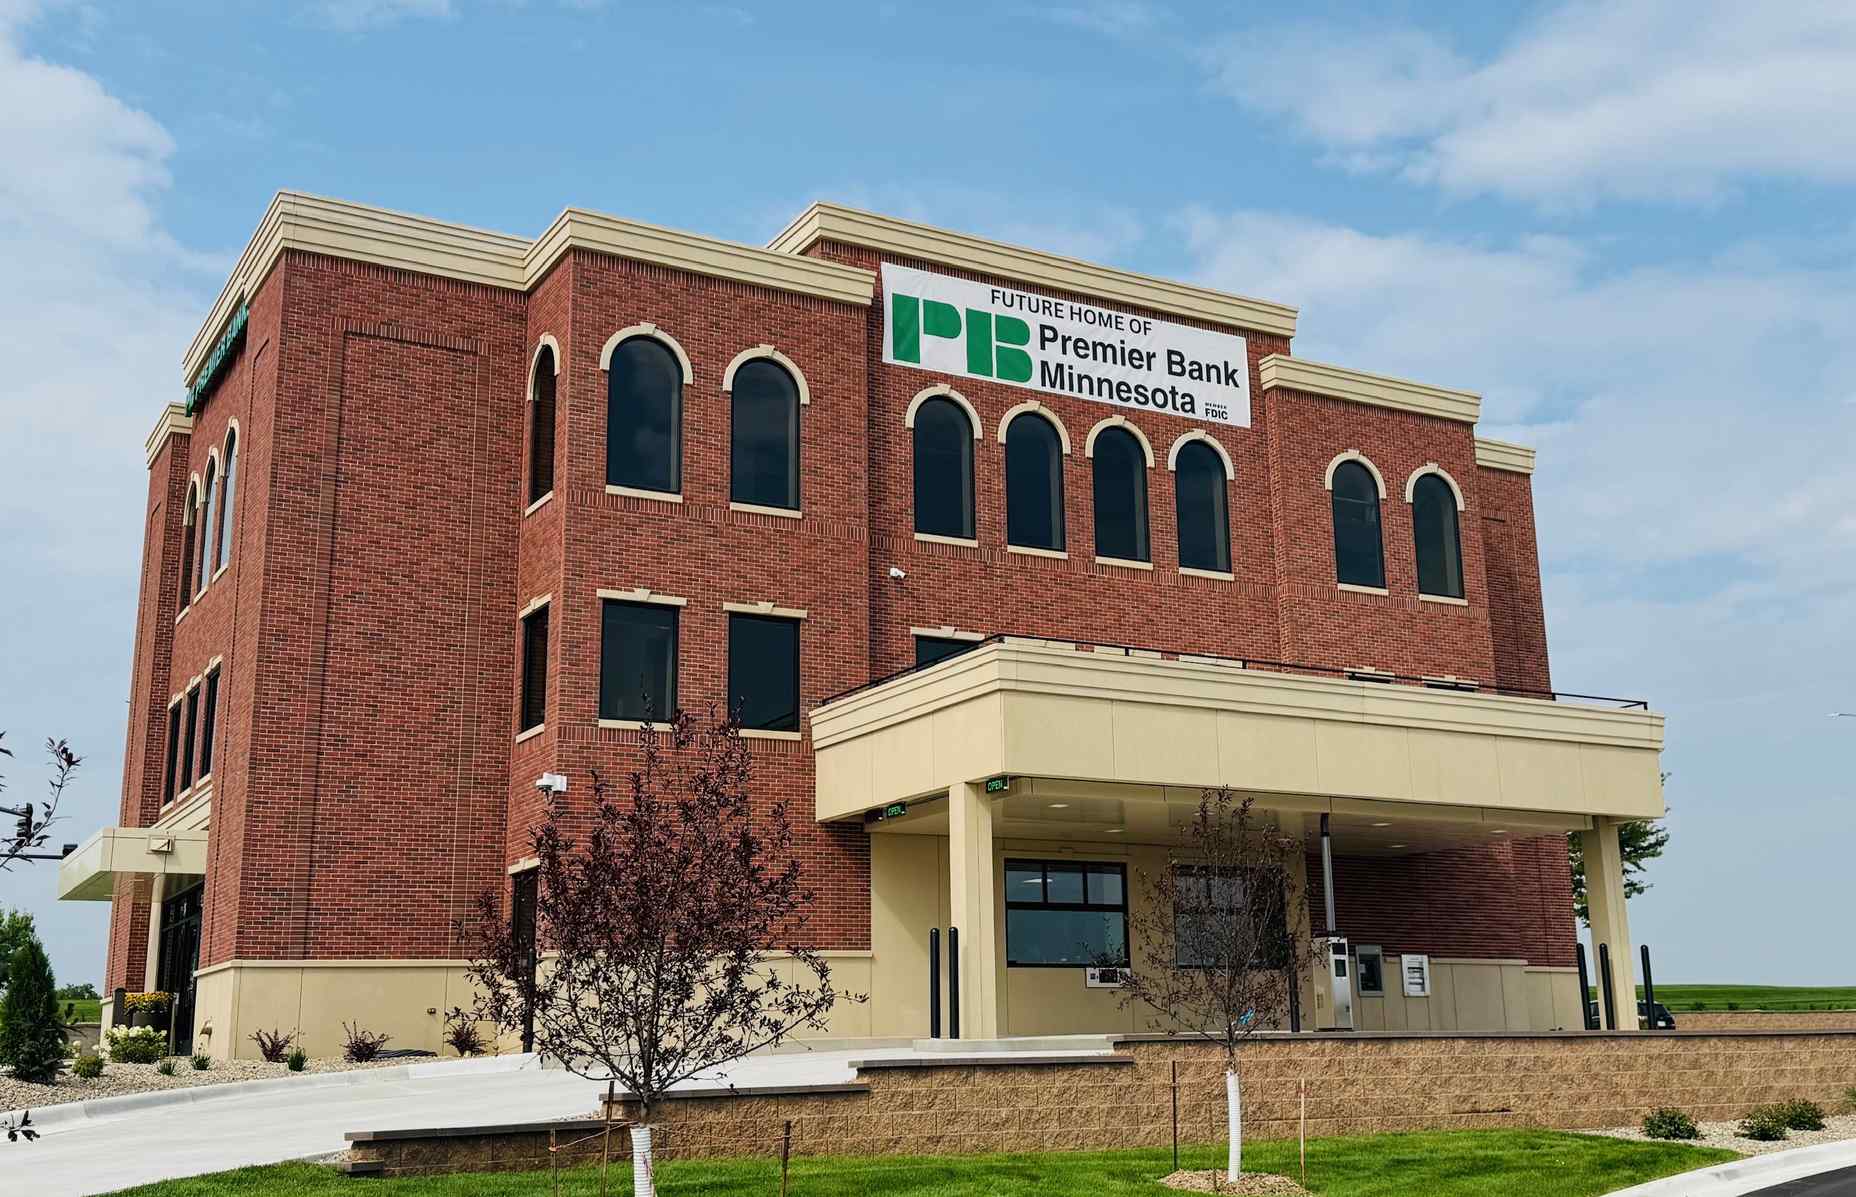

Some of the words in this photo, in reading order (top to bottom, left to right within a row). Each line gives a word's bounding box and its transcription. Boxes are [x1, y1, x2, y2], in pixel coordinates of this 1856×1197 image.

[991, 289, 1065, 319] FUTURE
[1070, 305, 1125, 331] HOME
[1129, 318, 1153, 336] OF
[1039, 323, 1157, 372] Premier
[1166, 348, 1241, 389] Bank
[1040, 360, 1196, 415] Minnesota
[1205, 408, 1228, 420] FDIC
[987, 780, 1003, 791] OPEN
